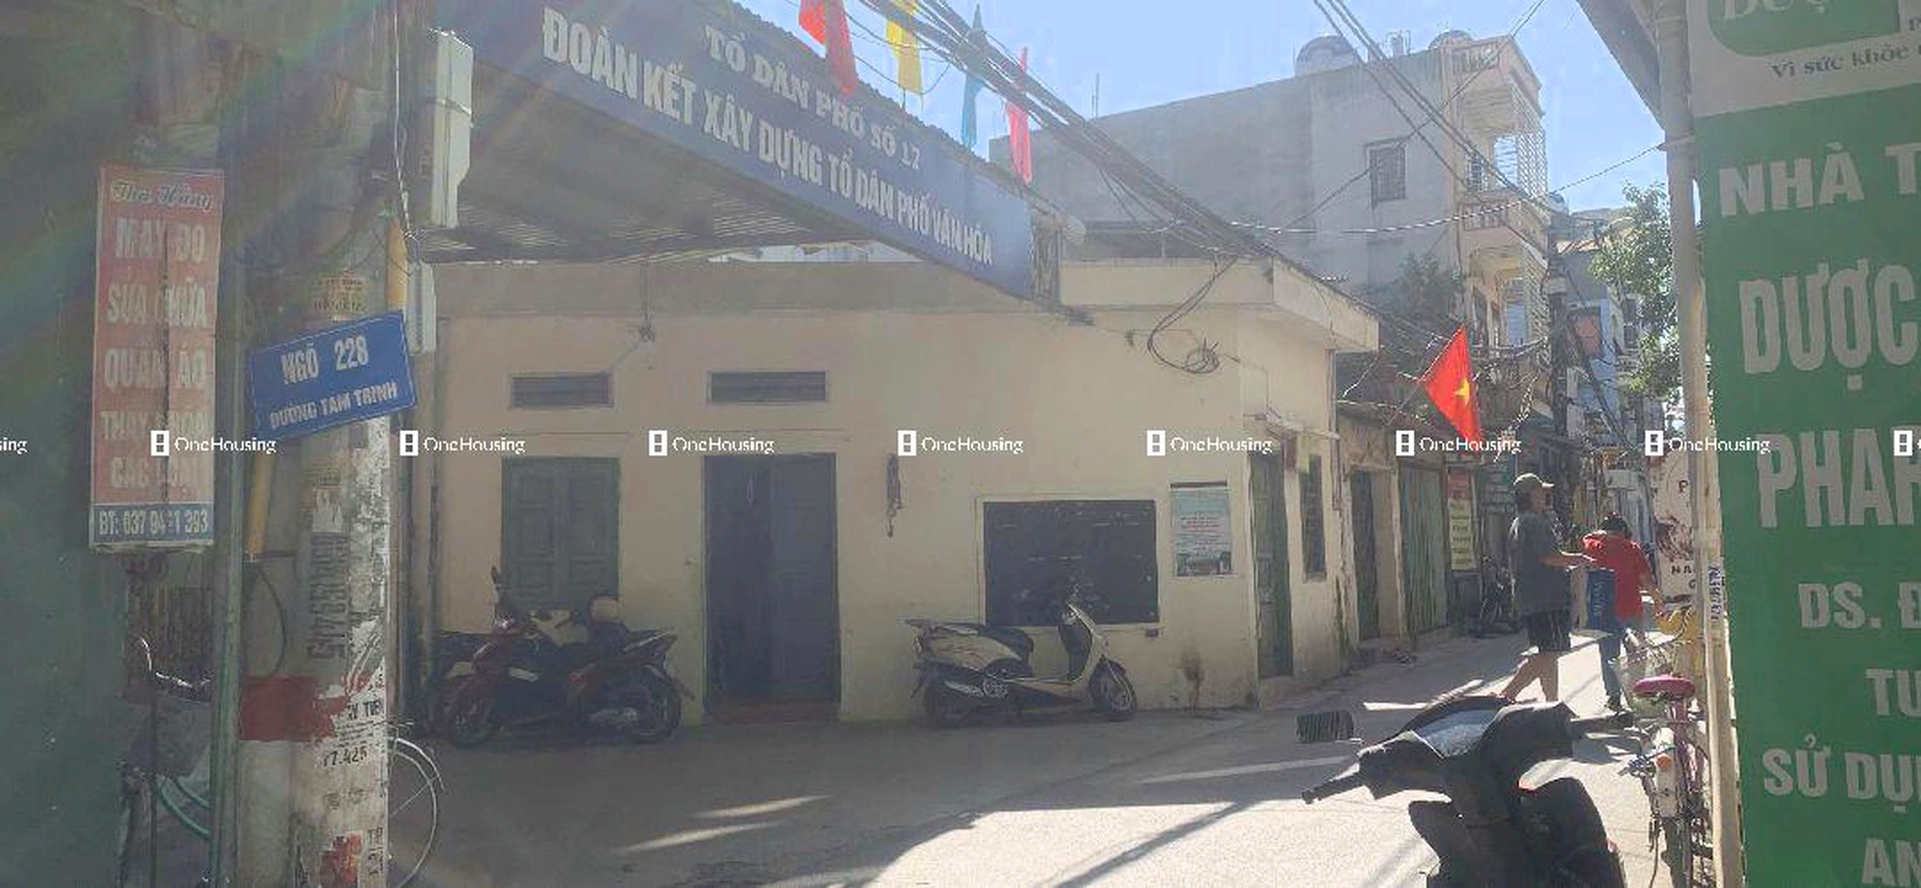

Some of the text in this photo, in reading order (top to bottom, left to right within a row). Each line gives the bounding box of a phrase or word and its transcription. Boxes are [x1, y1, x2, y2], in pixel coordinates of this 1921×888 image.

[704, 25, 747, 73] TỔ
[753, 53, 810, 109] DÂN
[815, 91, 866, 136] PHỐ
[871, 126, 896, 157] SỐ
[1772, 62, 1796, 78] Vì
[1803, 55, 1844, 74] sức
[542, 6, 638, 100] ĐOÀN
[643, 62, 697, 126] KẾT
[703, 88, 754, 152] XÂY
[758, 119, 823, 186] DỰNG
[827, 148, 853, 198] TỔ
[855, 169, 895, 220] DÂN
[897, 189, 931, 235] PHỐ
[1719, 141, 1865, 217] NHÀ
[1738, 257, 1918, 391] DƯỢC
[281, 335, 369, 384] NGÕ 228
[319, 392, 352, 416] TAM
[352, 381, 398, 407] TRINH
[123, 510, 146, 534] 037
[1799, 581, 1881, 629] DS.
[1762, 733, 1832, 798] SỬ
